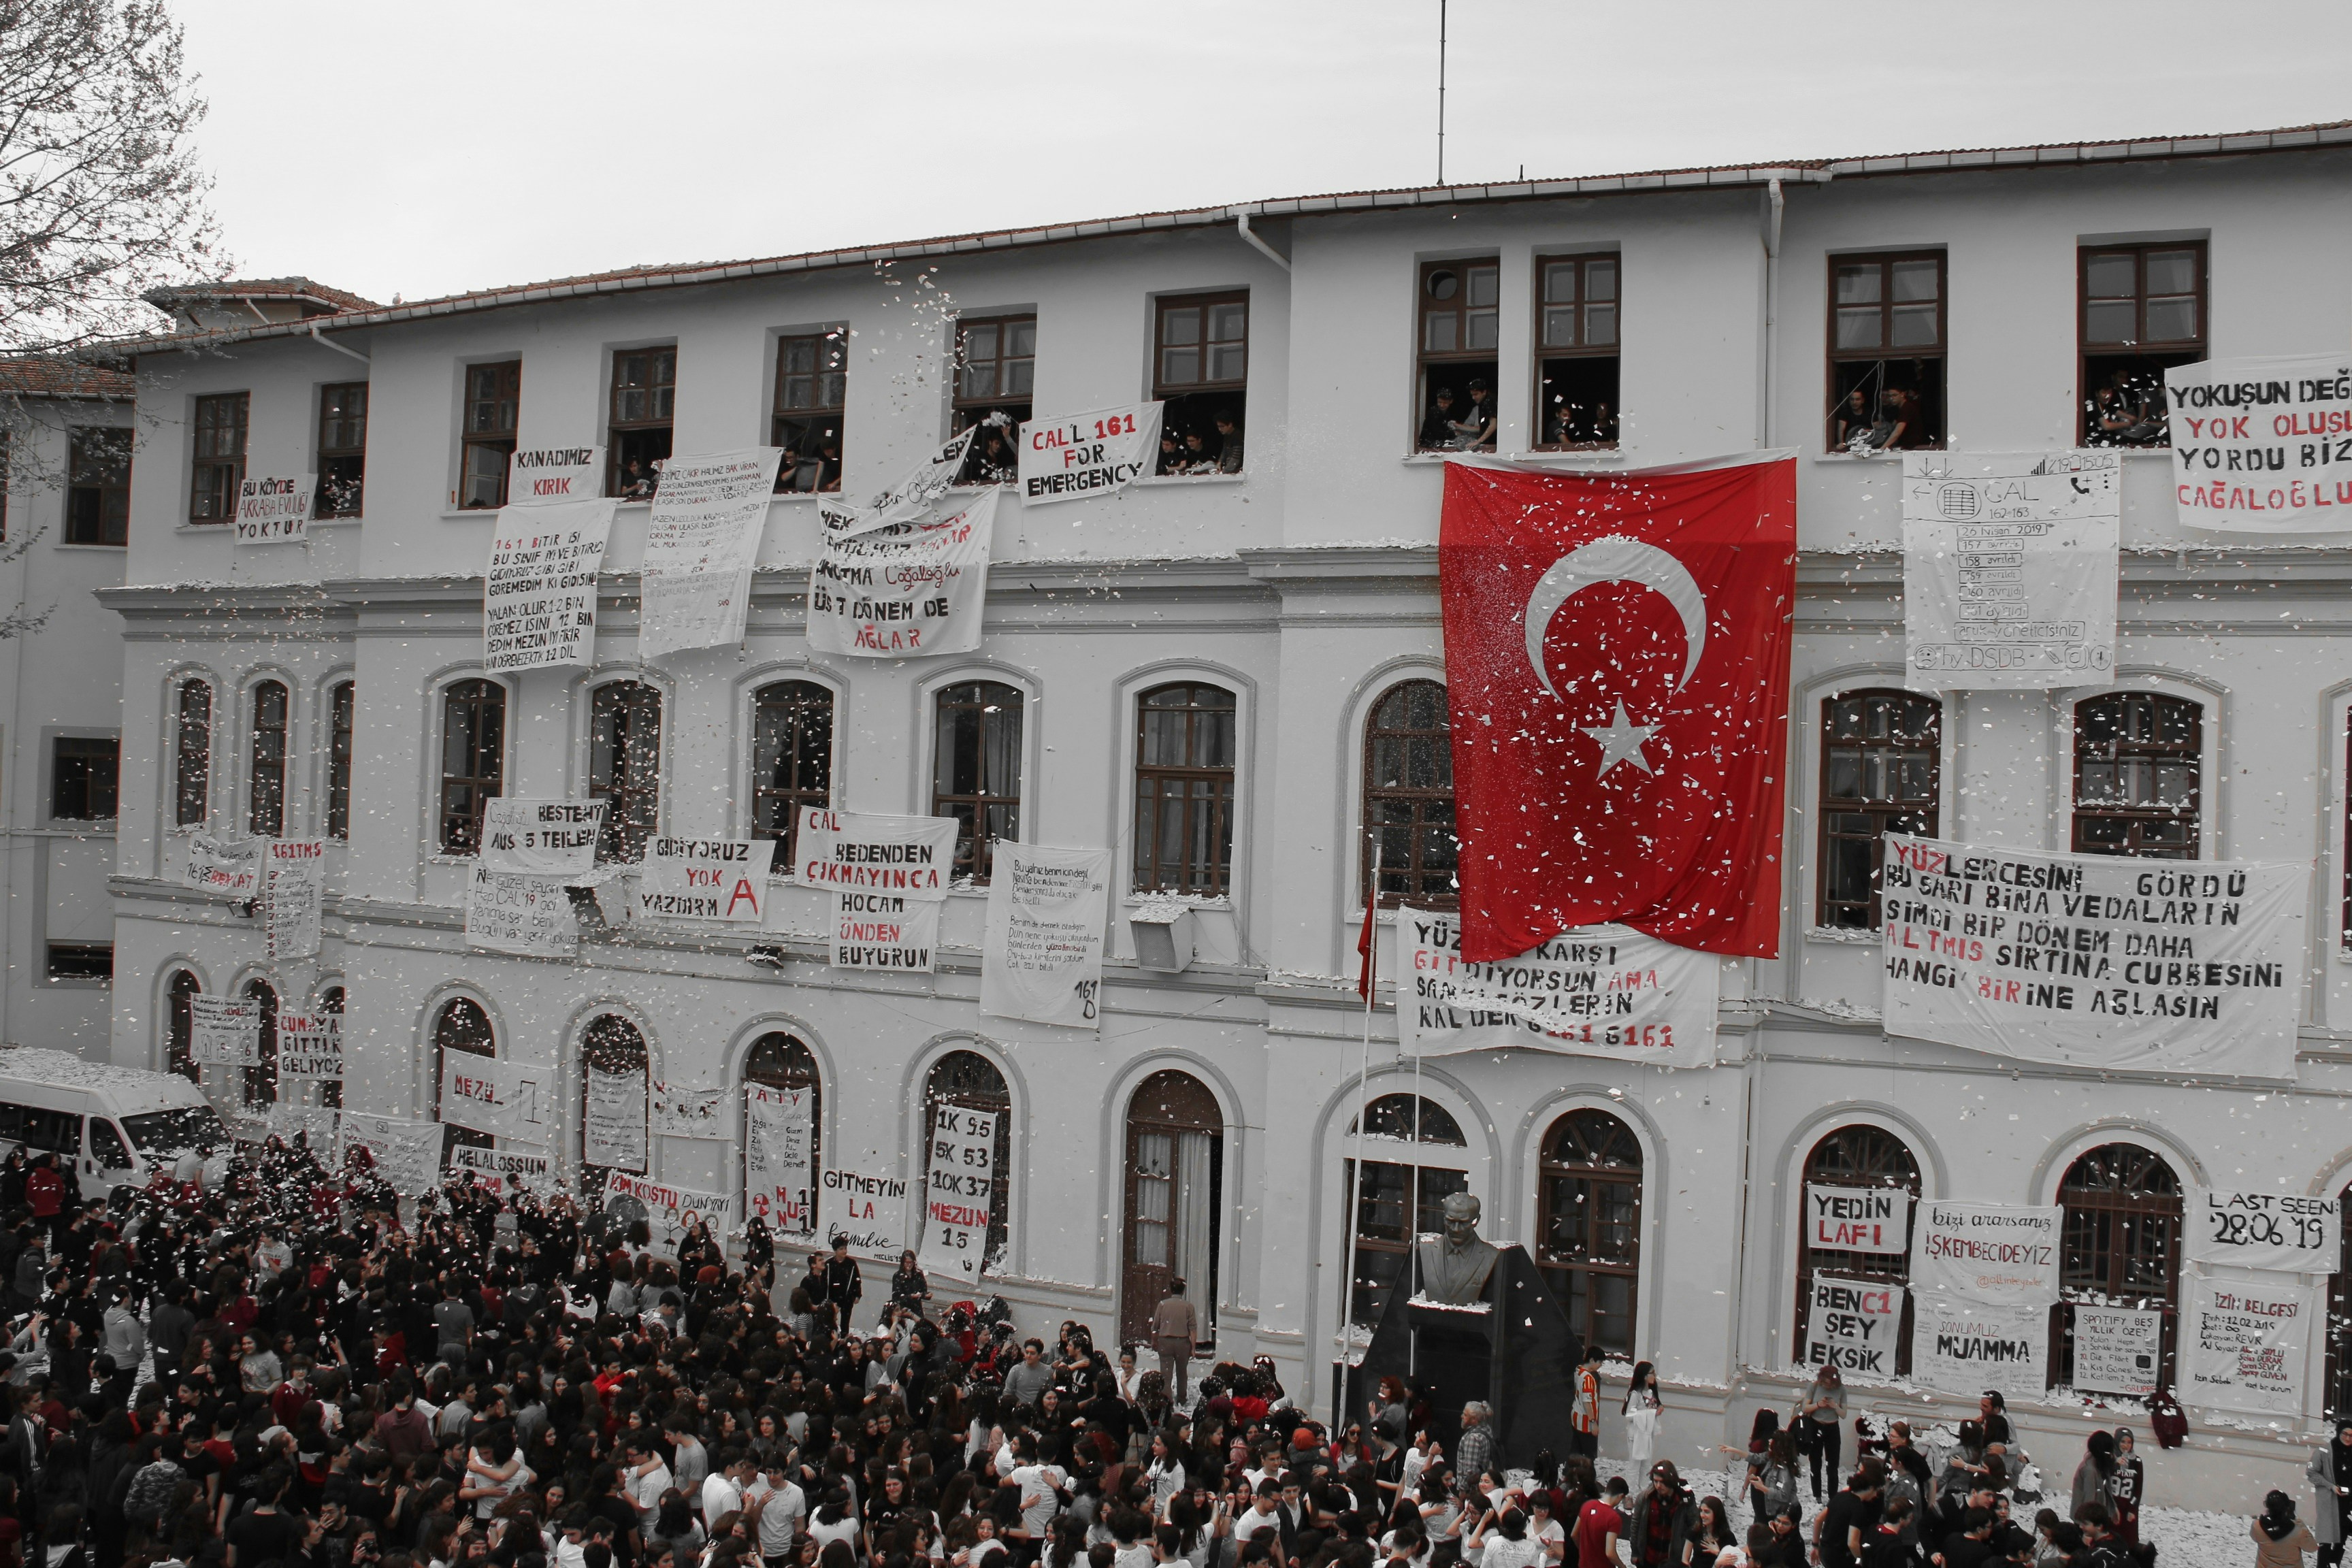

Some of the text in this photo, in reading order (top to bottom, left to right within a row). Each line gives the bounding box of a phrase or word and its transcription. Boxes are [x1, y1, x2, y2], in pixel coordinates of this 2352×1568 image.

[2170, 368, 2352, 411] YOKUŞUN DEĞ
[1032, 414, 1136, 451] CALL 161
[2185, 416, 2250, 439] YOK
[1064, 444, 1105, 469] FOR
[2178, 446, 2285, 471] YORDU
[534, 478, 571, 495] KIRIK
[1027, 462, 1143, 497] EMERGENCY
[238, 519, 304, 538] YOKTUR
[2016, 524, 2042, 535] 2019
[493, 553, 510, 566] BU
[1965, 556, 1981, 566] 158
[853, 596, 913, 620] DÖNEM
[924, 597, 949, 617] DE
[809, 811, 840, 832] CAL
[491, 832, 515, 850] AUS
[836, 843, 932, 863] BEDENDEN
[686, 868, 723, 887] YOK
[2137, 870, 2246, 898] GÖRDÜ
[841, 894, 904, 913] HOCAM
[840, 916, 900, 942] ÖNDEN
[2017, 919, 2110, 953] DÖNEM
[2125, 934, 2193, 958] DAHA
[839, 945, 928, 968] BUYURUN
[1075, 980, 1098, 998] 161
[1607, 969, 1658, 992] AMA
[935, 1141, 956, 1163] 5K
[823, 1170, 906, 1198] GİTMEYİN
[932, 1169, 963, 1195] 10K
[849, 1198, 875, 1220] LA
[928, 1200, 989, 1228] MEZUN
[1814, 1191, 1891, 1220] YEDİN
[2209, 1189, 2340, 1215] LAST SEEN:
[1932, 1207, 1965, 1232] bizi
[1818, 1220, 1881, 1246] LAFI
[1825, 1312, 1878, 1341] ŞEY
[2082, 1314, 2127, 1326] SPOTIFY
[1810, 1341, 1884, 1373] EKSİK
